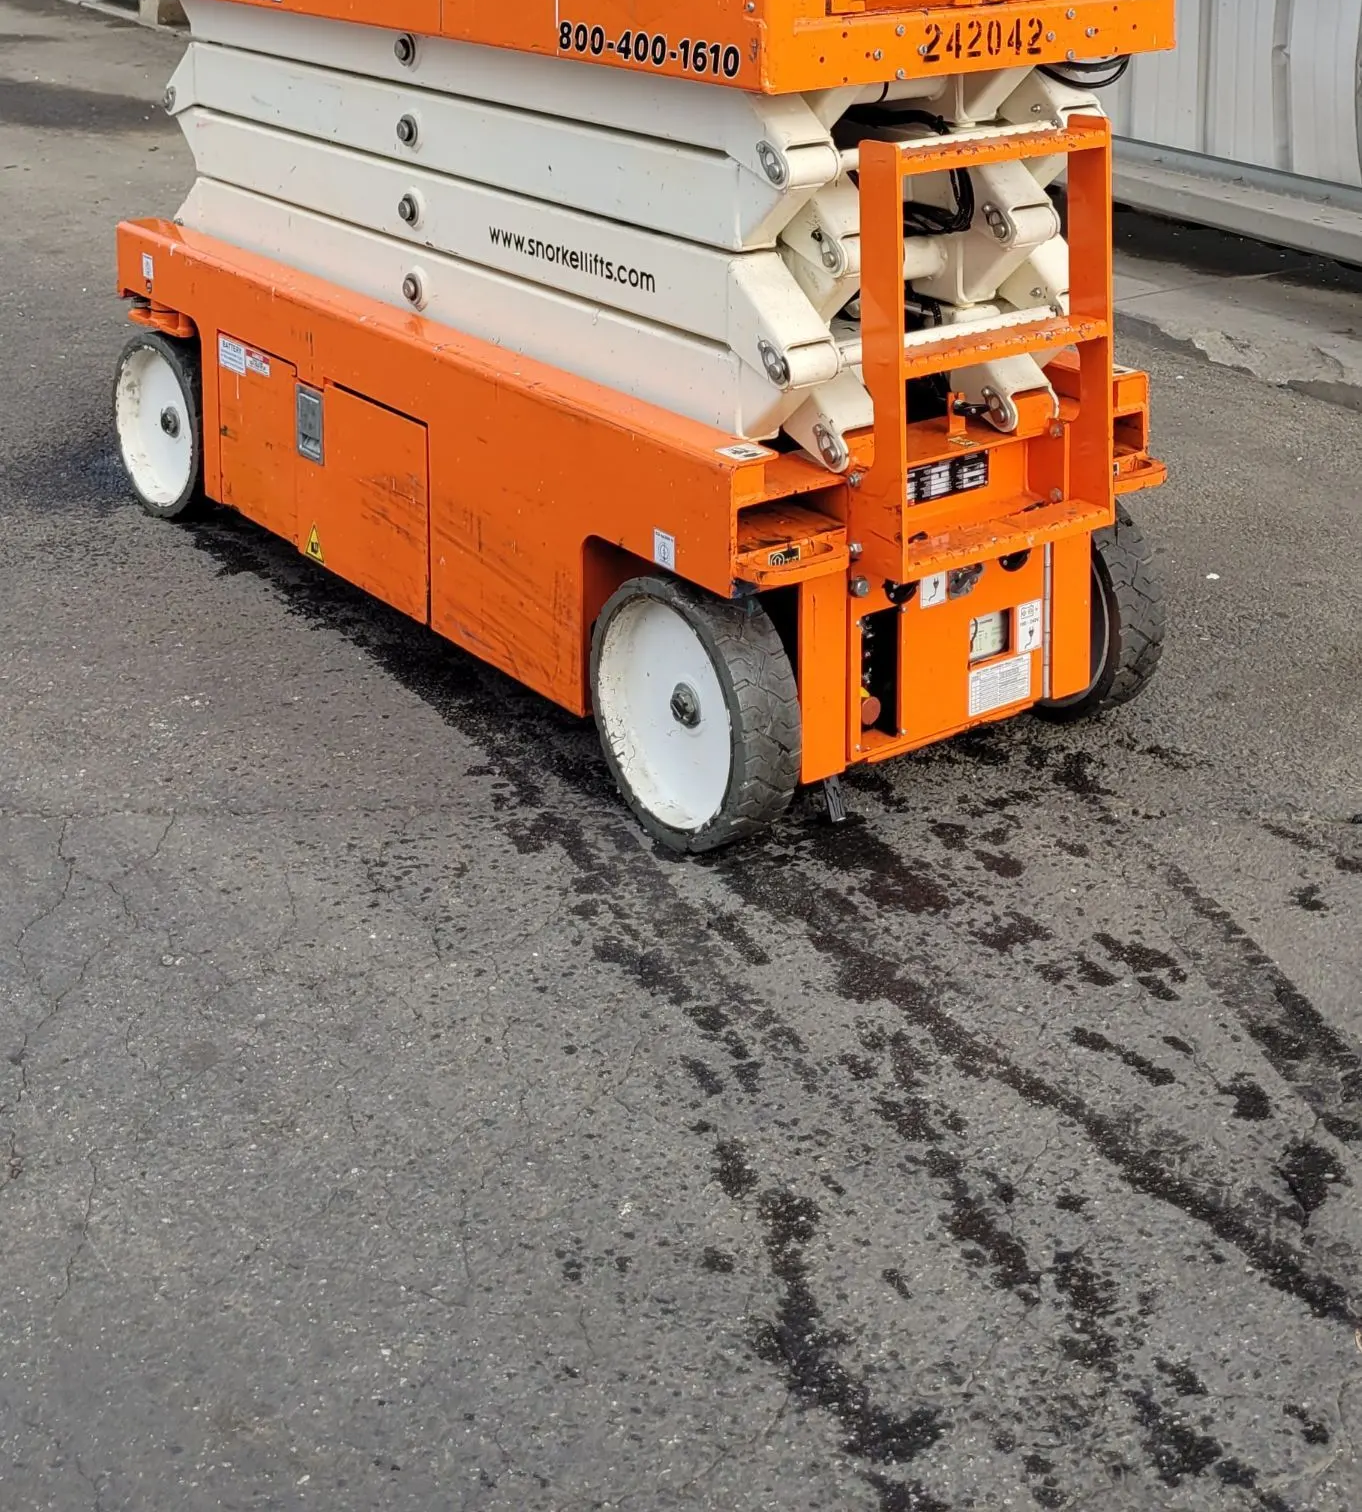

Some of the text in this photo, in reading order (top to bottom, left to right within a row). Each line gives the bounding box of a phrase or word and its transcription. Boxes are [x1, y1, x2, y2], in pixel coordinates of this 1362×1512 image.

[558, 20, 741, 78] 800-400-1610
[923, 17, 1043, 62] 242042
[488, 225, 656, 294] www.snorkellifts.com
